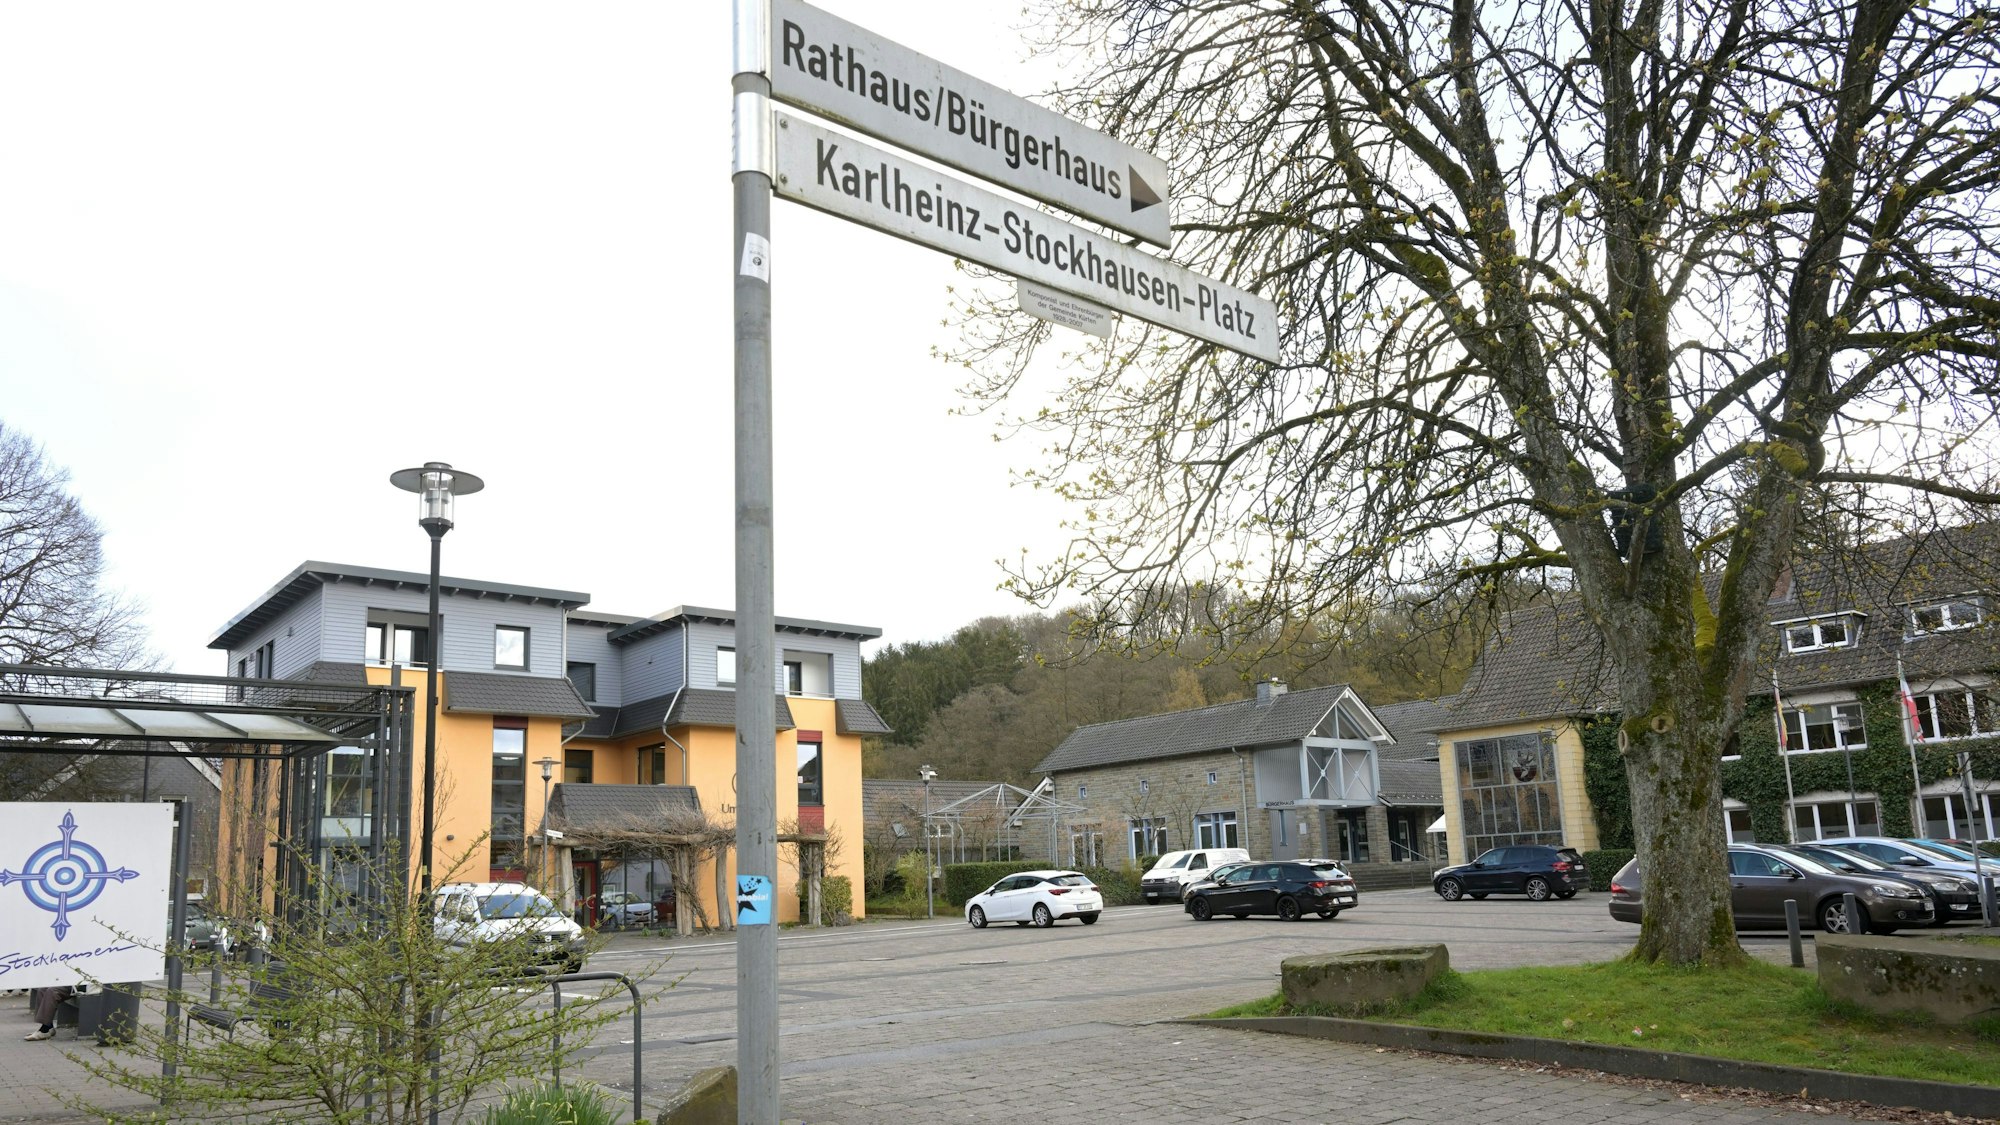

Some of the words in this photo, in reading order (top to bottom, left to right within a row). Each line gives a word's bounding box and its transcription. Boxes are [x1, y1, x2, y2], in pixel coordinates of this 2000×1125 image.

[784, 19, 1122, 200] Rathaus/Bürgerhaus
[816, 138, 1256, 340] Karlheinz-Stockhausen-Platz
[1027, 289, 1058, 304] Komponist
[1059, 301, 1070, 309] und
[1072, 303, 1104, 320] Ehrenbürger
[1037, 301, 1047, 309] der
[1049, 304, 1077, 318] Gemeinde
[0, 944, 138, 975] Stockhausen
